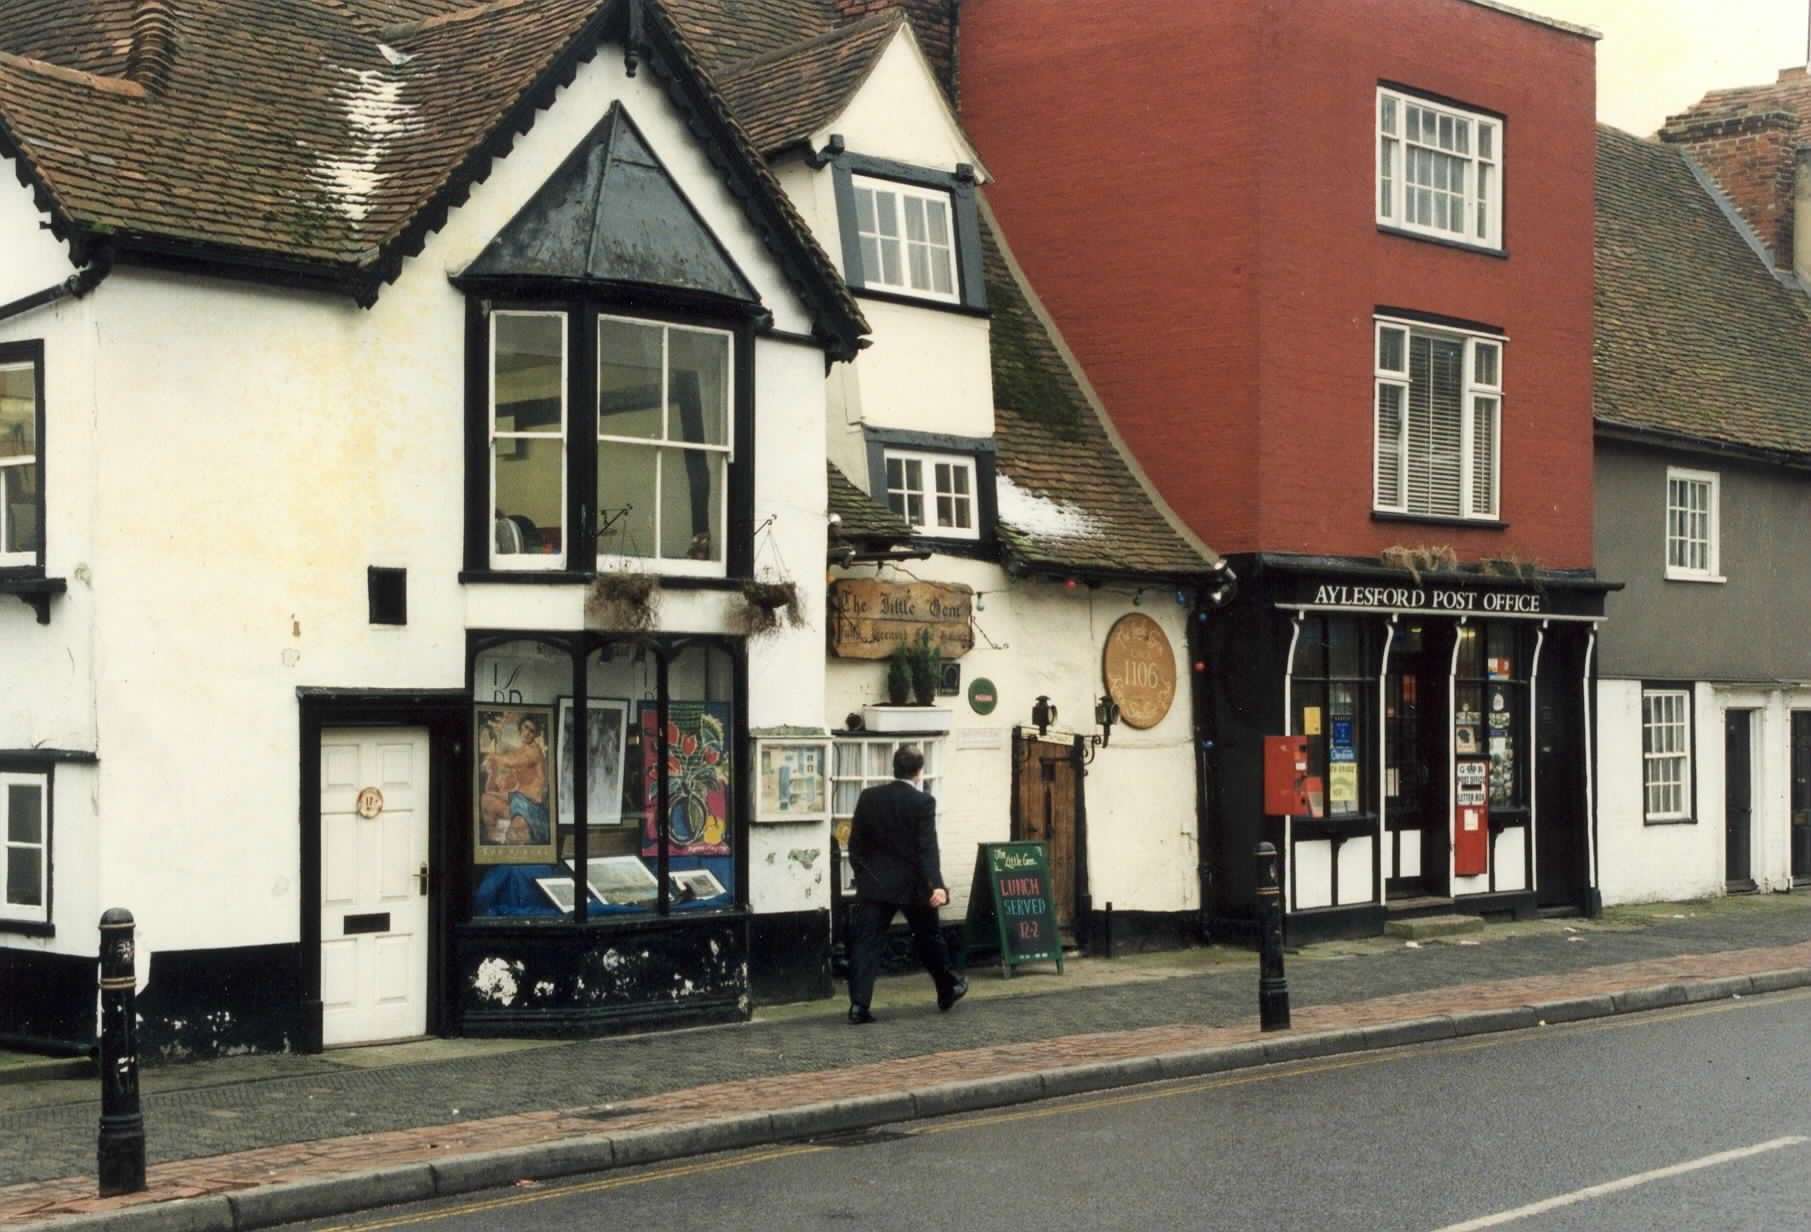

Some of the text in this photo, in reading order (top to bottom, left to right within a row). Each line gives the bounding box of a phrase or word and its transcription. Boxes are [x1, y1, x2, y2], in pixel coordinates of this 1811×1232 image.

[841, 590, 867, 615] The
[1314, 585, 1541, 613] AYLESFORD POST OFFICE
[1125, 660, 1159, 689] 1106
[1000, 879, 1040, 897] LUNCH
[1006, 898, 1046, 913] SERVED
